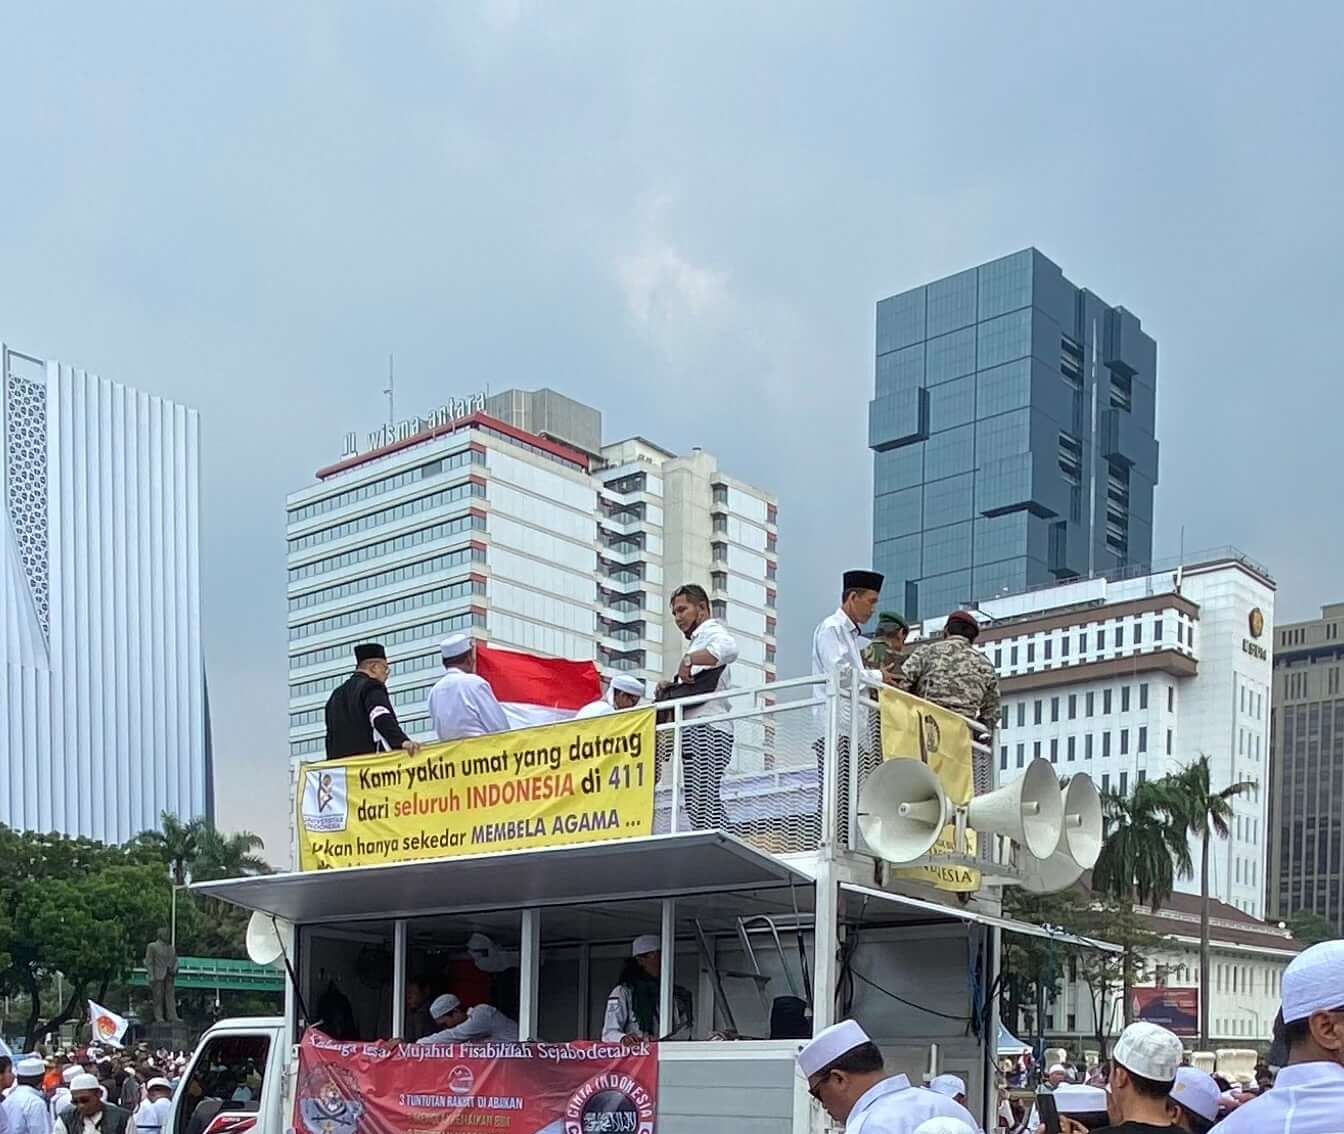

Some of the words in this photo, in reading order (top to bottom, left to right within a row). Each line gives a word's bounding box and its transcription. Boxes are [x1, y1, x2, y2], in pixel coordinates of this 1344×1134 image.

[367, 415, 421, 451] wisma
[427, 391, 487, 430] antara
[359, 762, 402, 790] Kami
[405, 756, 455, 785] yakin
[462, 752, 508, 777] umat
[514, 744, 561, 775] yang
[569, 732, 642, 762] datang
[357, 799, 389, 822] dari
[393, 792, 461, 818] seluruh
[466, 773, 575, 809] INDONESIA
[582, 769, 601, 794] di
[608, 762, 645, 790] 411
[357, 837, 399, 858] hanya
[403, 828, 467, 850] sekedar
[471, 817, 546, 845] MEMBELA
[551, 808, 620, 835] AGAMA
[398, 1043, 454, 1062] Mujahid
[567, 1083, 593, 1118] CINTA
[595, 1073, 653, 1118] INDONESIA
